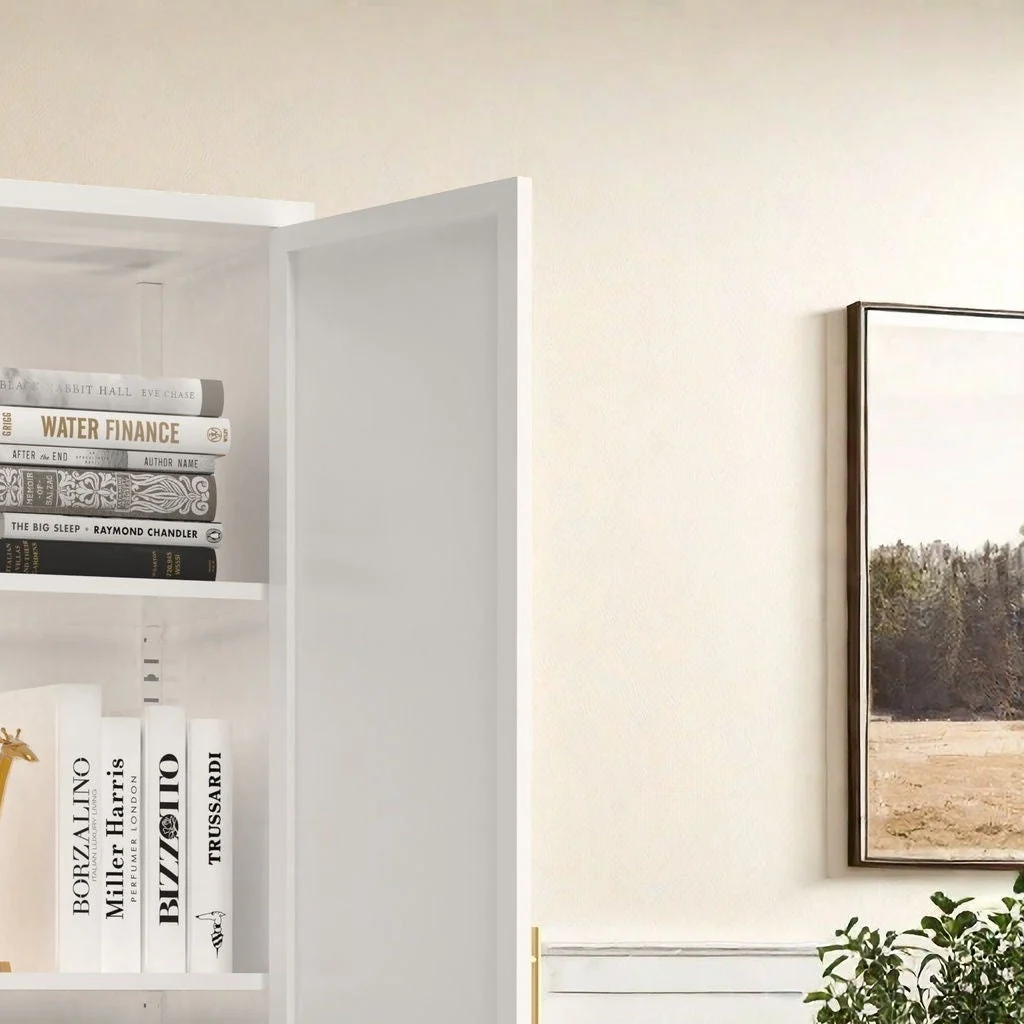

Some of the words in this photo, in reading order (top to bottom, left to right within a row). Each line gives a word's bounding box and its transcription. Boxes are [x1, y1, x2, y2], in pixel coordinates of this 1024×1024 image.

[99, 386, 132, 397] HALL
[141, 389, 160, 398] EVE
[164, 390, 195, 399] CHASE
[2, 412, 12, 437] GRIGG
[41, 416, 99, 440] WATER
[106, 419, 180, 444] FINANCE
[12, 450, 36, 460] AFTER
[40, 453, 51, 461] the
[52, 451, 68, 462] END
[144, 457, 173, 467] AUTHOR
[178, 459, 199, 469] NAME
[12, 522, 29, 531] THE
[33, 522, 50, 532] BIG
[54, 523, 81, 533] SLEEP
[93, 525, 144, 537] RAYMOND
[148, 527, 198, 539] CHANDLER
[105, 758, 125, 838] Harris
[208, 752, 222, 866] TRUSSARDI
[72, 757, 91, 916] BORZALINO
[105, 845, 124, 920] Miller
